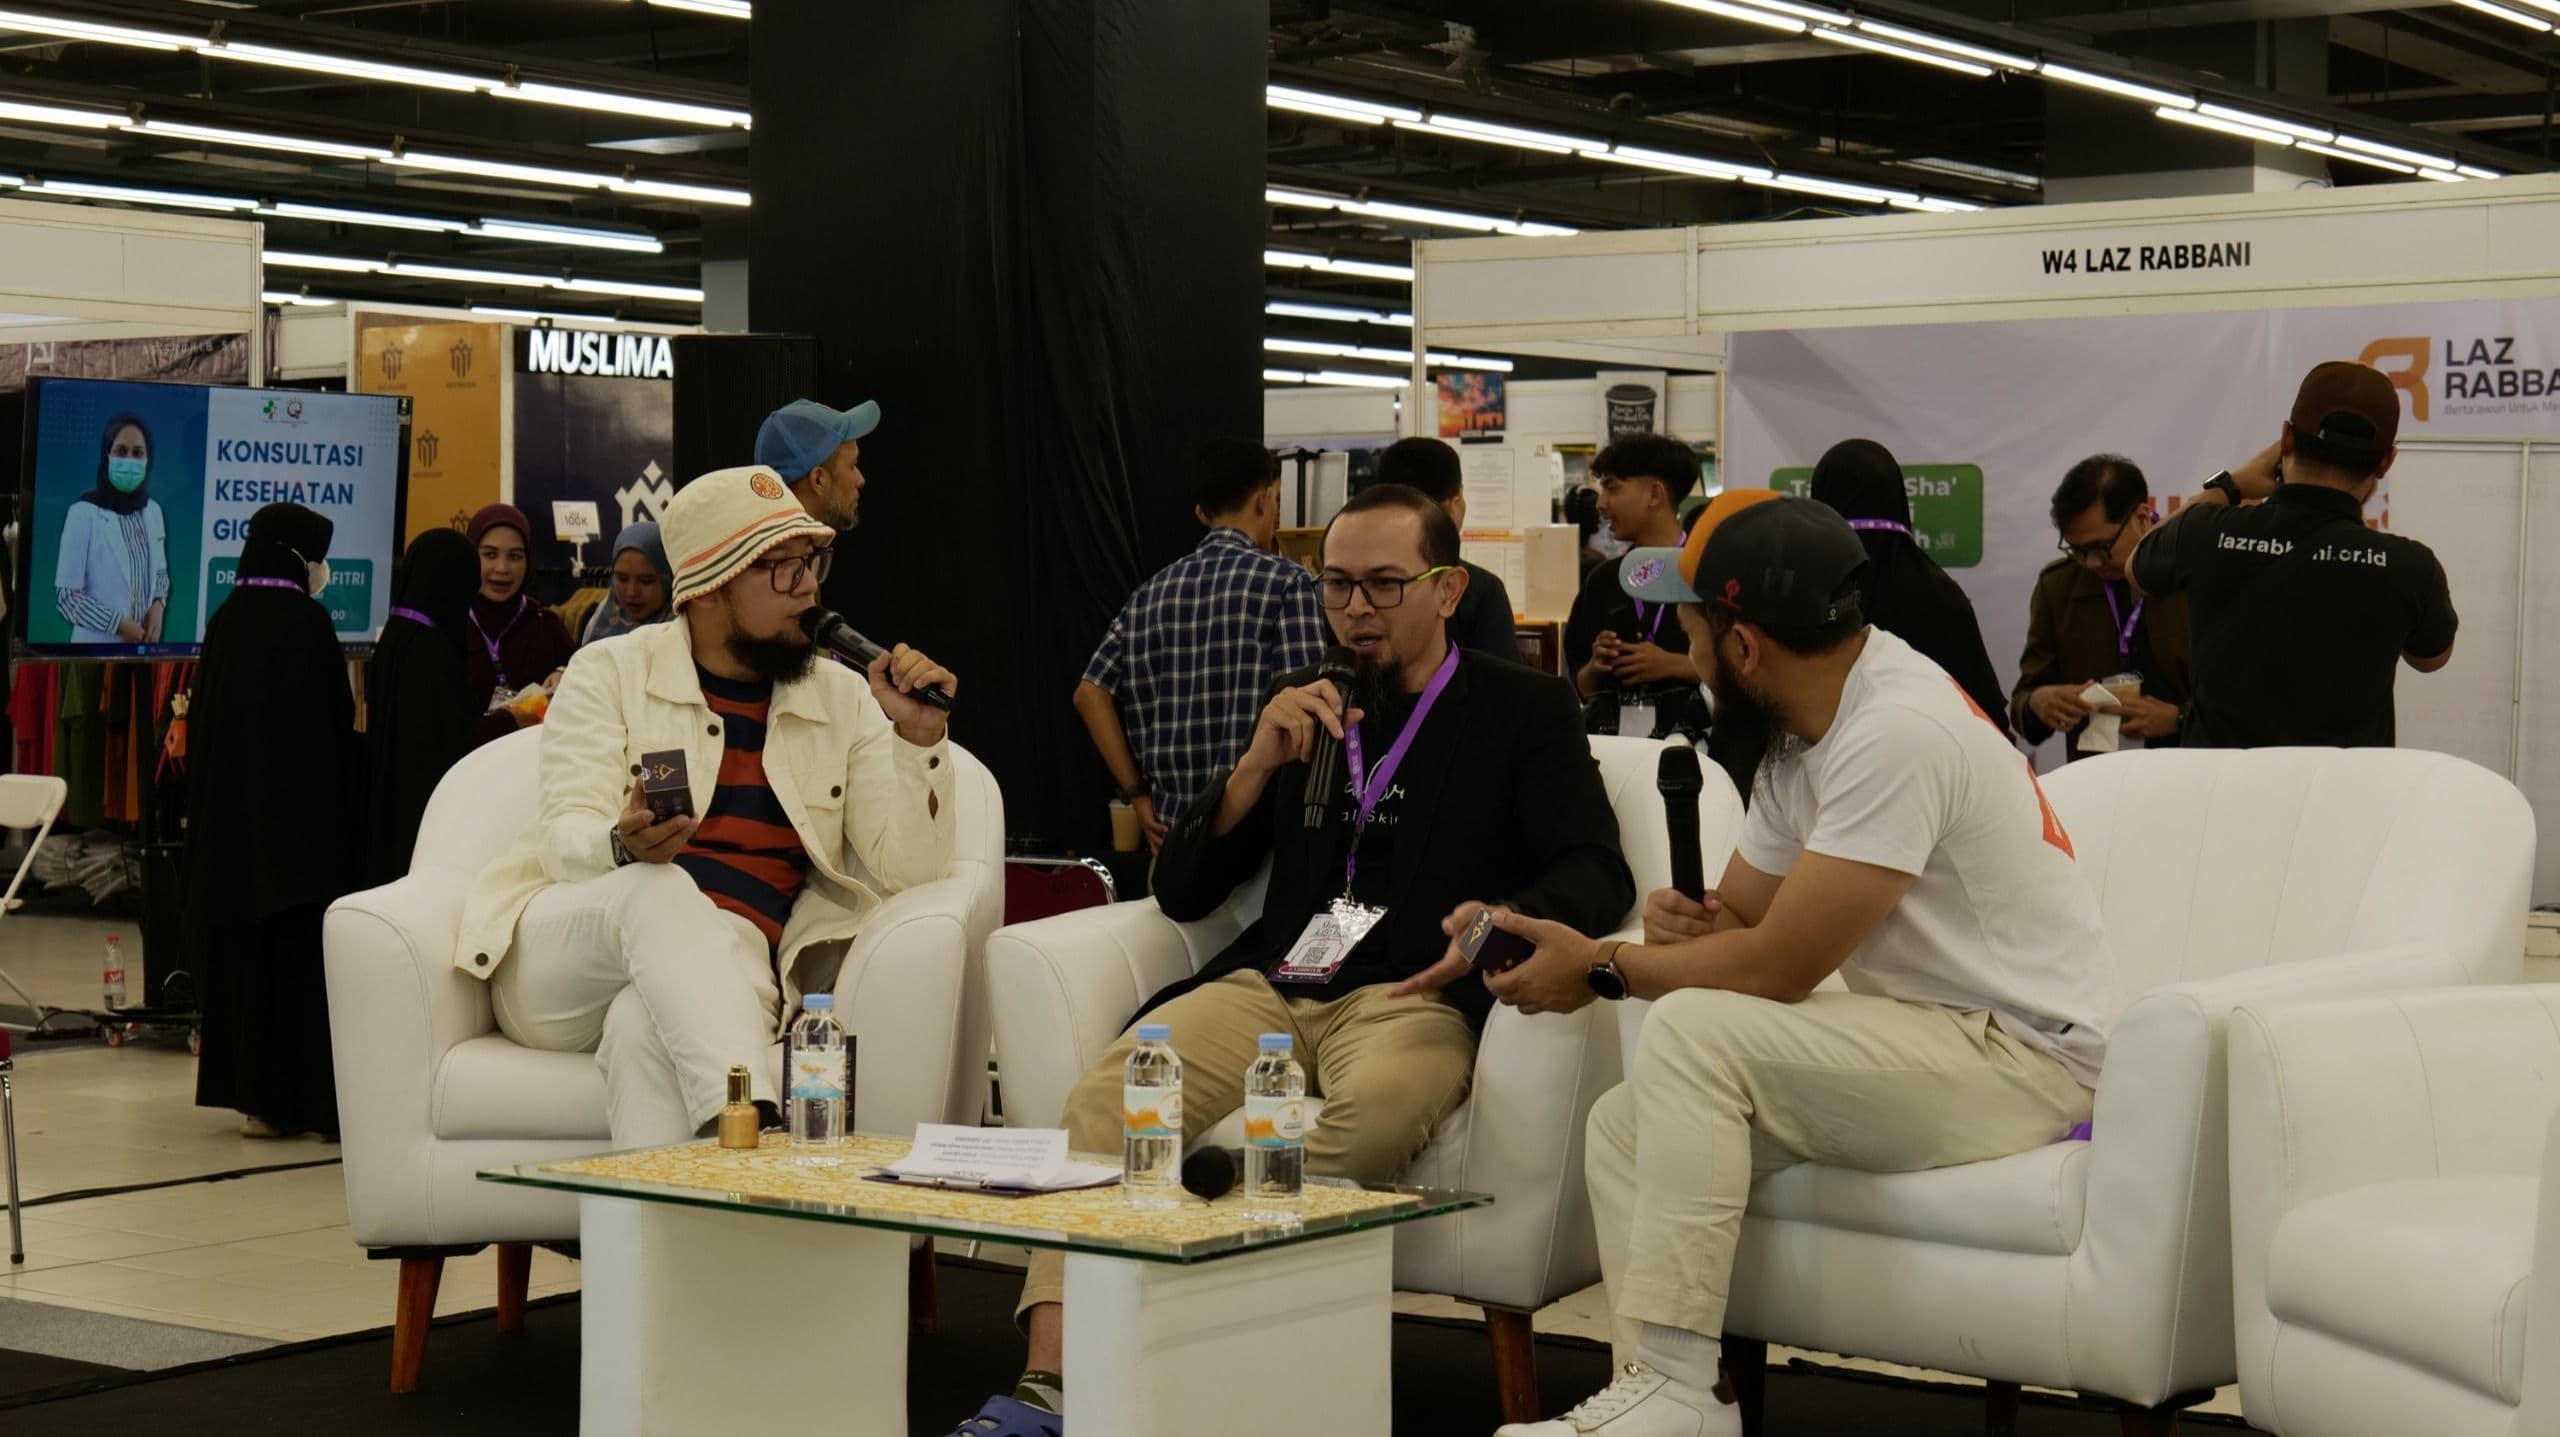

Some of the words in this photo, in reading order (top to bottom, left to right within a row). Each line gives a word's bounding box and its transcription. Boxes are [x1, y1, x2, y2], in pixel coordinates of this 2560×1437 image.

[2042, 249, 2077, 274] W4
[2085, 247, 2131, 272] LAZ
[2139, 242, 2251, 271] RABBANI
[528, 329, 674, 378] MUSLIMA
[2445, 337, 2515, 367] LAZ
[2445, 368, 2560, 400] RABBA
[217, 439, 364, 467] KONSULTASI
[215, 479, 354, 505] KESEHATAN
[1904, 475, 1957, 497] Sha'
[329, 570, 365, 586] FITRI
